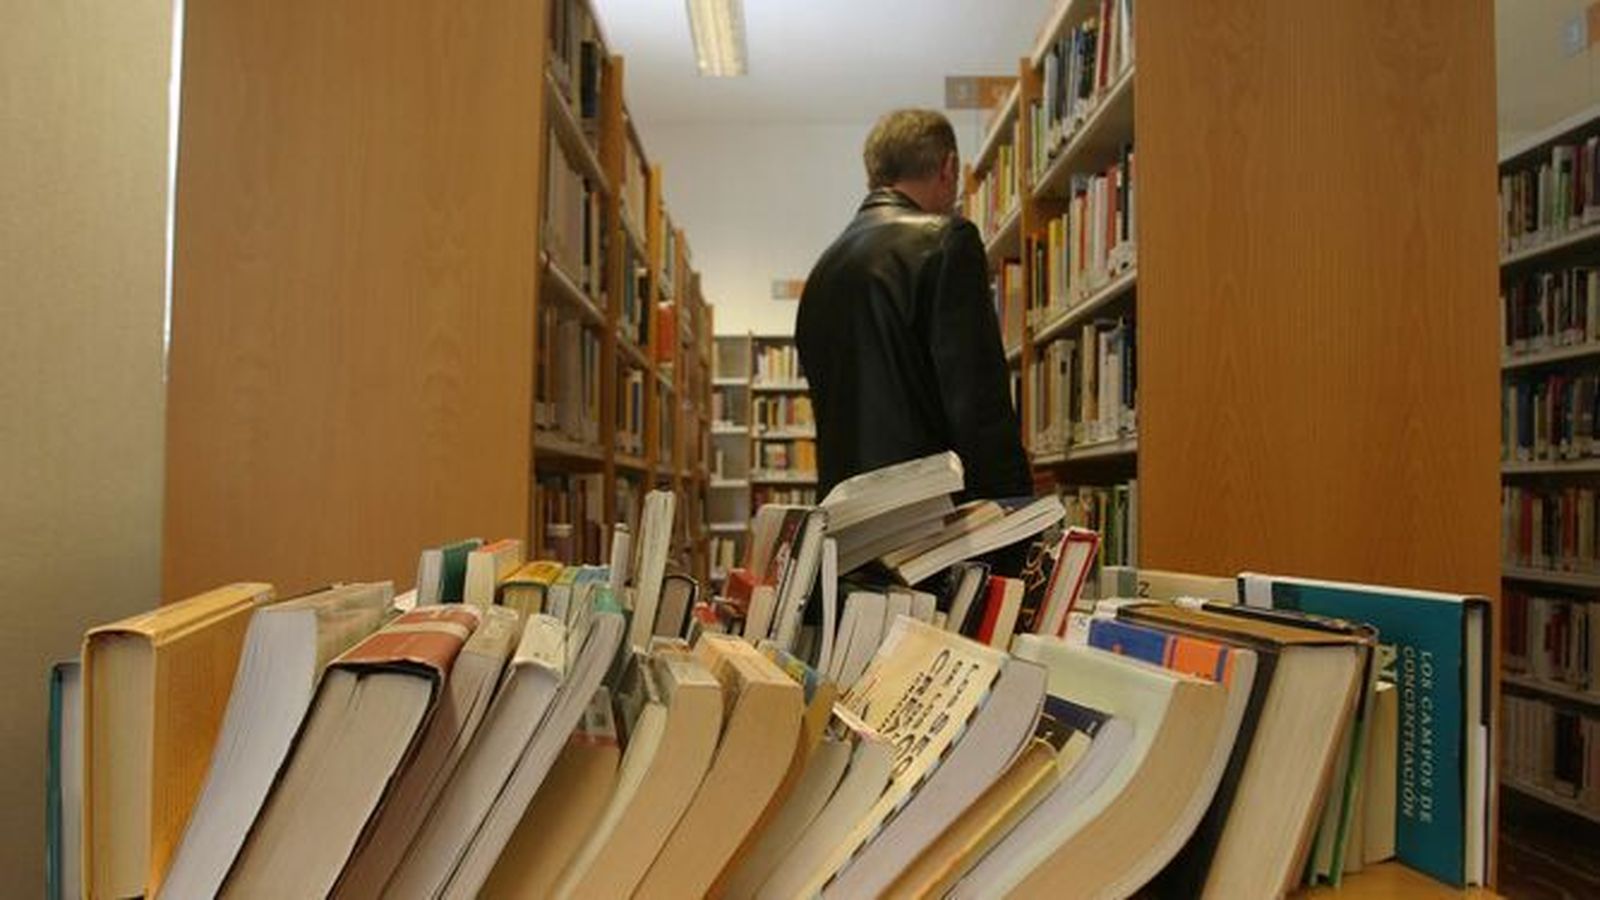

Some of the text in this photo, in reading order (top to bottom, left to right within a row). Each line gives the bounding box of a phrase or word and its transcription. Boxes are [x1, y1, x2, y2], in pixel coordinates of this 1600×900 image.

[882, 649, 951, 734] CREA
[1419, 651, 1434, 823] LOS CAMPOS DE
